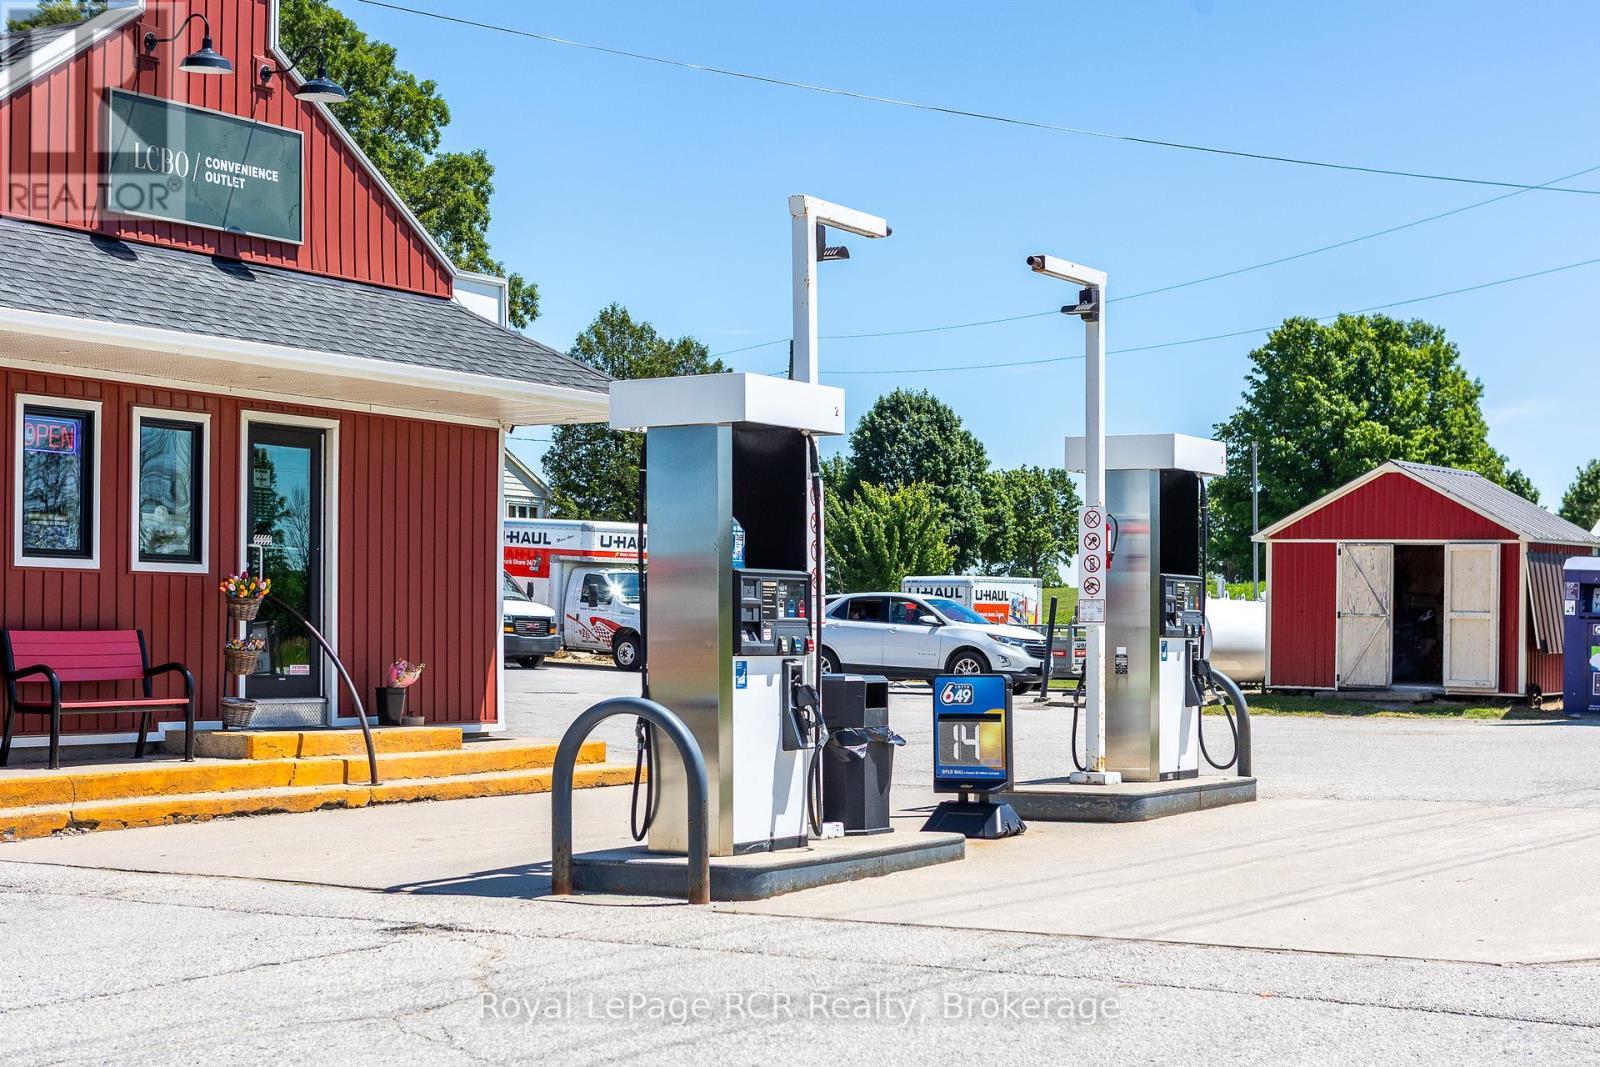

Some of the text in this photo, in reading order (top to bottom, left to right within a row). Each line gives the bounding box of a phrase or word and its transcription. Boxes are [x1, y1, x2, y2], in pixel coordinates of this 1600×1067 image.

[133, 141, 190, 178] LCBO
[204, 156, 280, 182] CONVENIENCE
[204, 171, 246, 189] OUTLET
[834, 406, 839, 416] 2
[25, 422, 74, 449] OPEN
[504, 531, 552, 545] -HAUL
[975, 590, 1009, 602] U-HAUL
[952, 723, 981, 761] 14
